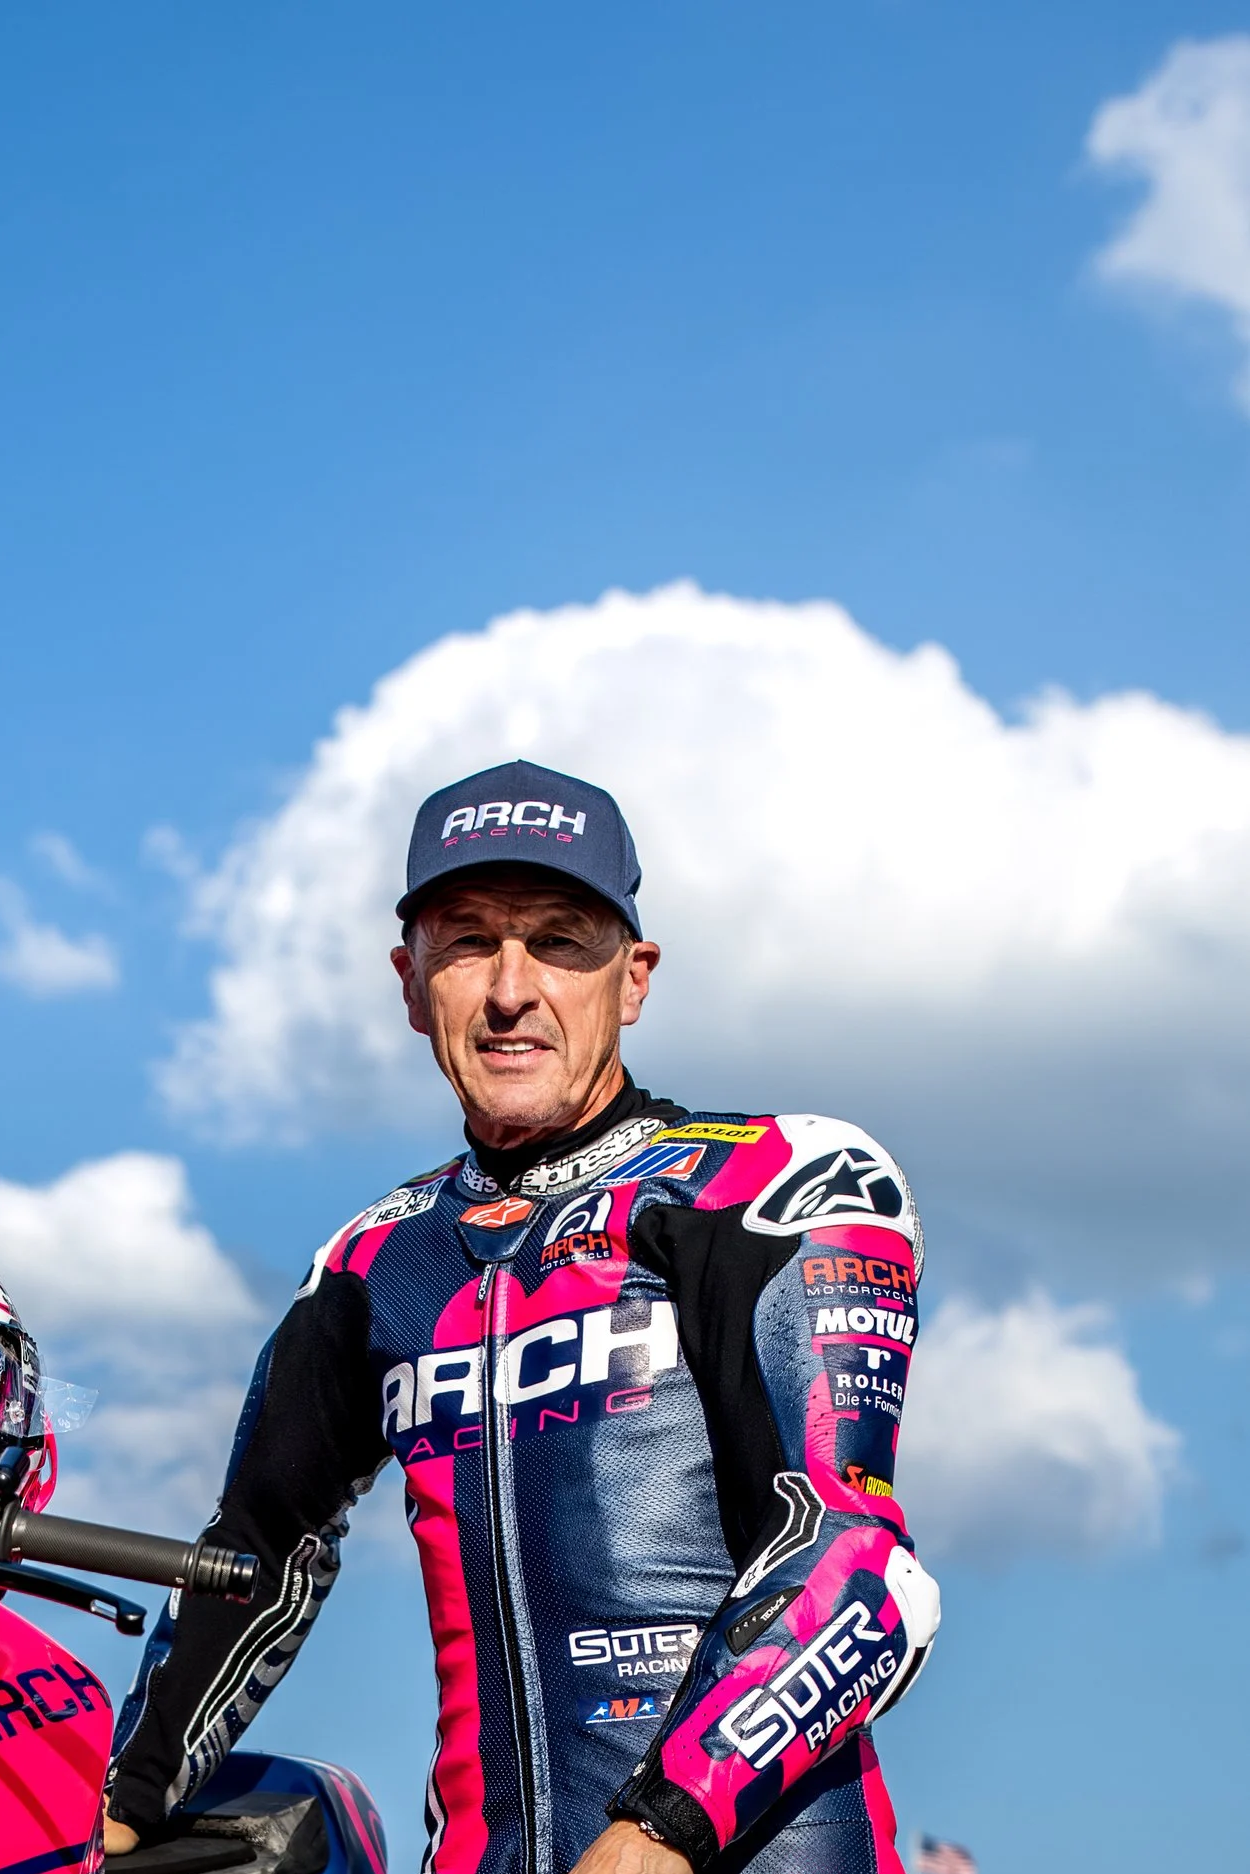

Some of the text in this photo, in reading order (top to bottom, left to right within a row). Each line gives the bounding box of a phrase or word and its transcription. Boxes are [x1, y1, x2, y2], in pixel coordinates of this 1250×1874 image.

[441, 801, 586, 839] ARCH
[444, 826, 573, 848] RACING
[520, 1117, 661, 1192] alpinestars
[374, 1197, 432, 1224] HELMET
[540, 1250, 610, 1273] MOTORCYCLE
[541, 1233, 609, 1264] ARCH
[803, 1257, 912, 1293] ARCH
[807, 1285, 915, 1306] MOTORCYCLE
[815, 1307, 915, 1345] MOTUL
[382, 1301, 679, 1441] ARCH
[836, 1374, 903, 1402] ROLLER
[836, 1391, 860, 1406] Die
[394, 1386, 654, 1462] ACING
[569, 1624, 699, 1666] SUTER
[617, 1658, 691, 1678] RACIN
[718, 1601, 886, 1770] SUTER
[805, 1650, 897, 1751] RACING
[587, 1697, 658, 1721] AMA
